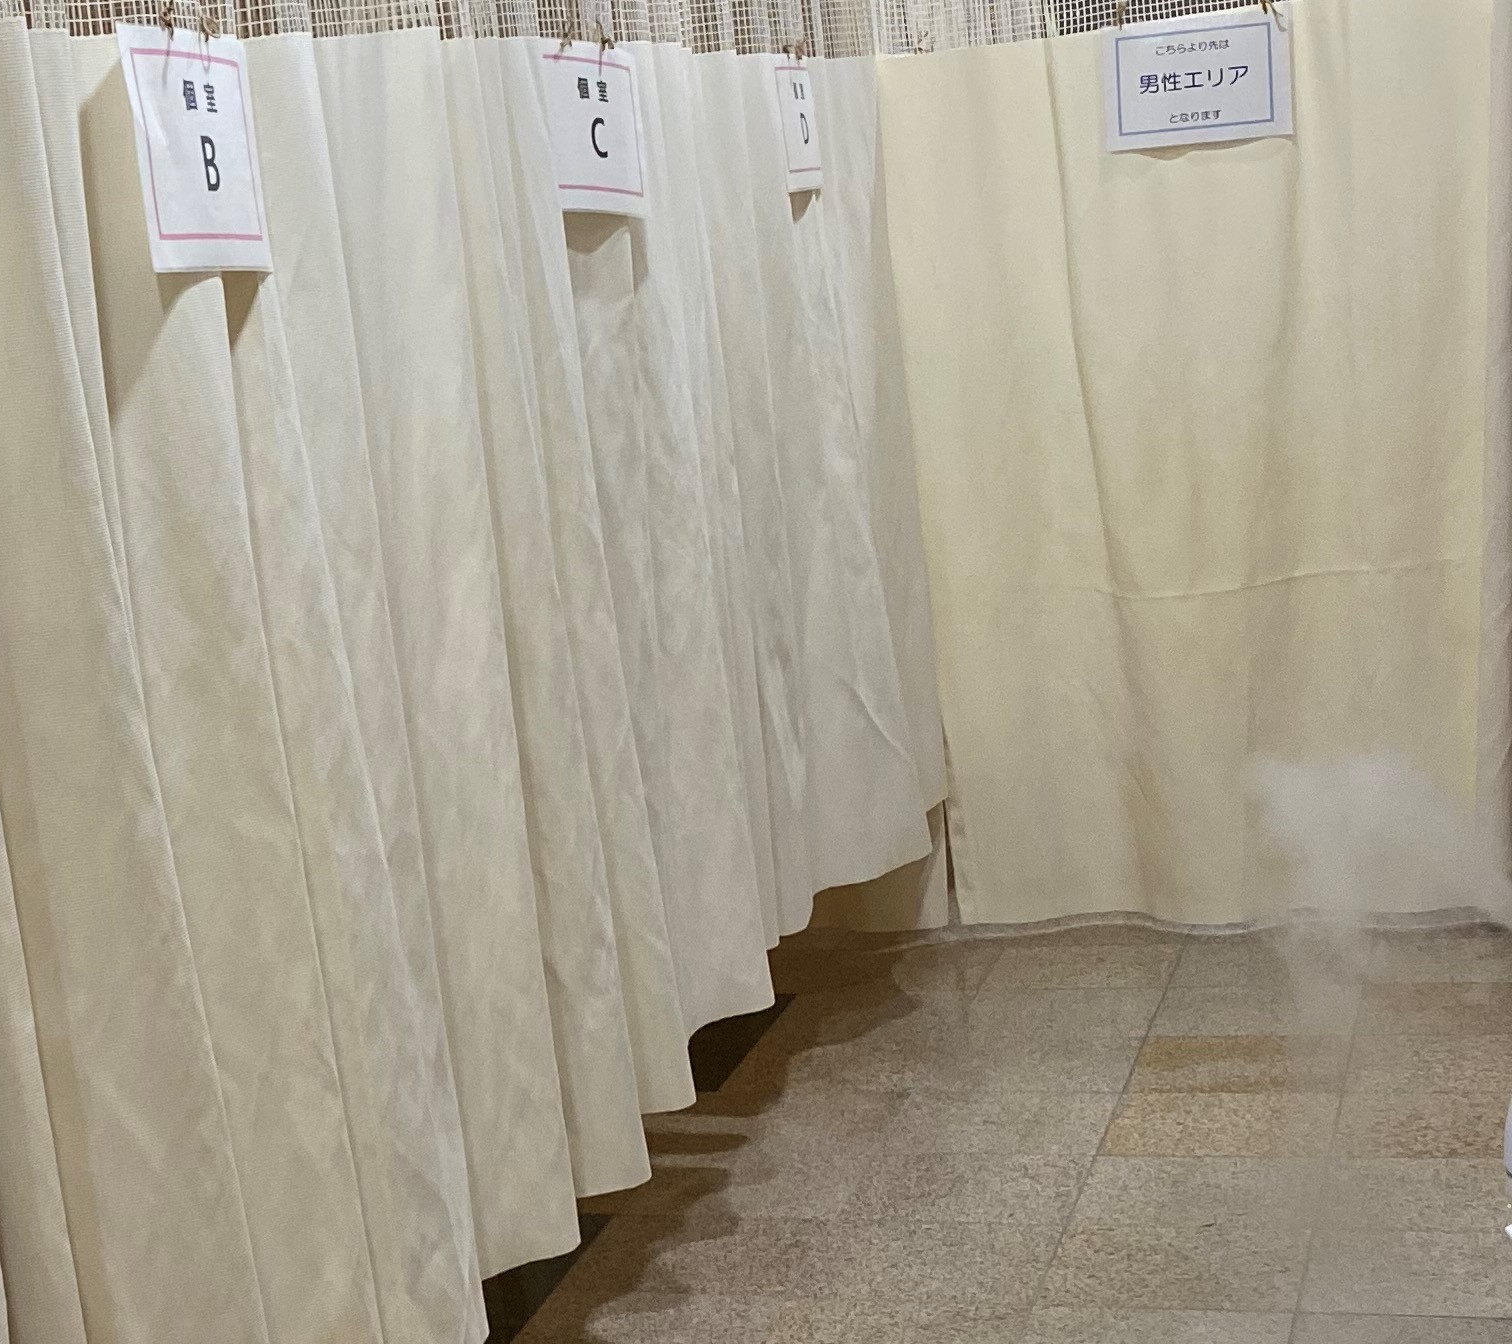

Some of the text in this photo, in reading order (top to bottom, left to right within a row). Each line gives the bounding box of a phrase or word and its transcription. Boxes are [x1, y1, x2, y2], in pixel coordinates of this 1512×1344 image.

[1155, 39, 1230, 56] こちらより先は
[1139, 65, 1249, 95] 男性エリア
[1169, 109, 1222, 124] となります
[590, 117, 609, 159] C
[200, 135, 221, 192] B
